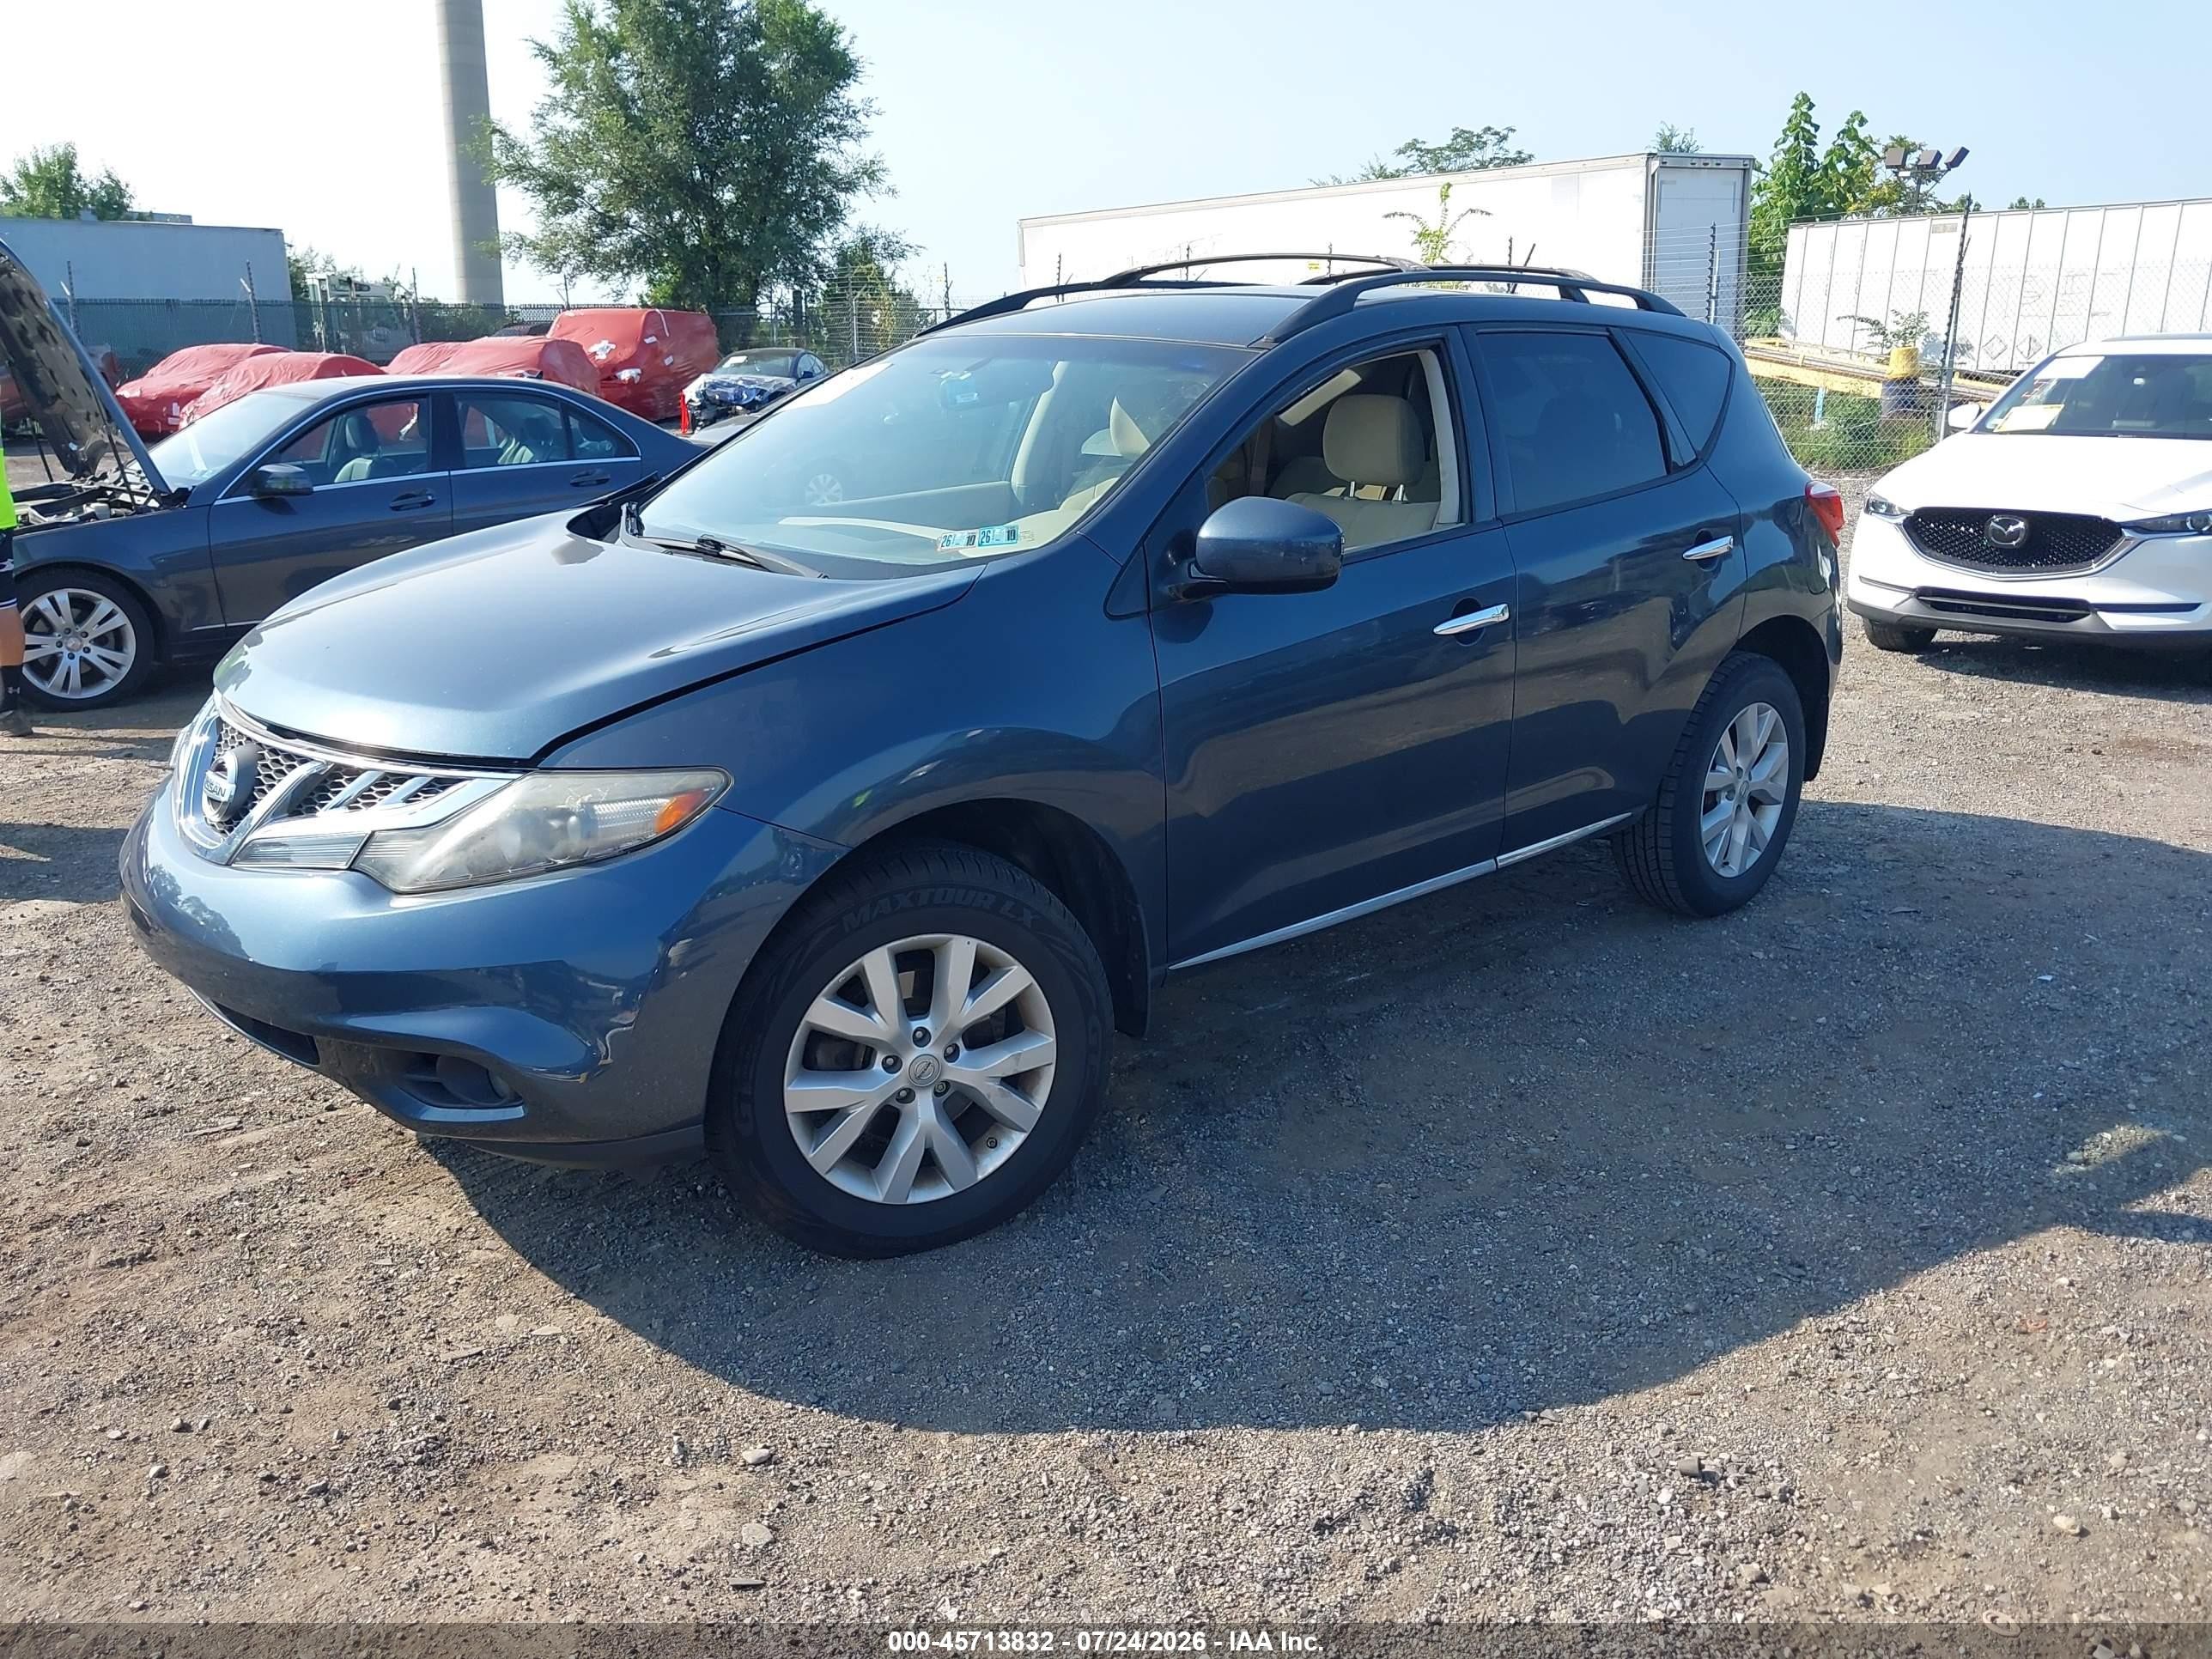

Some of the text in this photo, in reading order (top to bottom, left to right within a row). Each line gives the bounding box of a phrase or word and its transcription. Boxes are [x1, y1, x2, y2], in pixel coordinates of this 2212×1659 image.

[940, 534, 951, 548] 26
[980, 530, 991, 544] 26
[842, 887, 1042, 933] MAXTOUR LX
